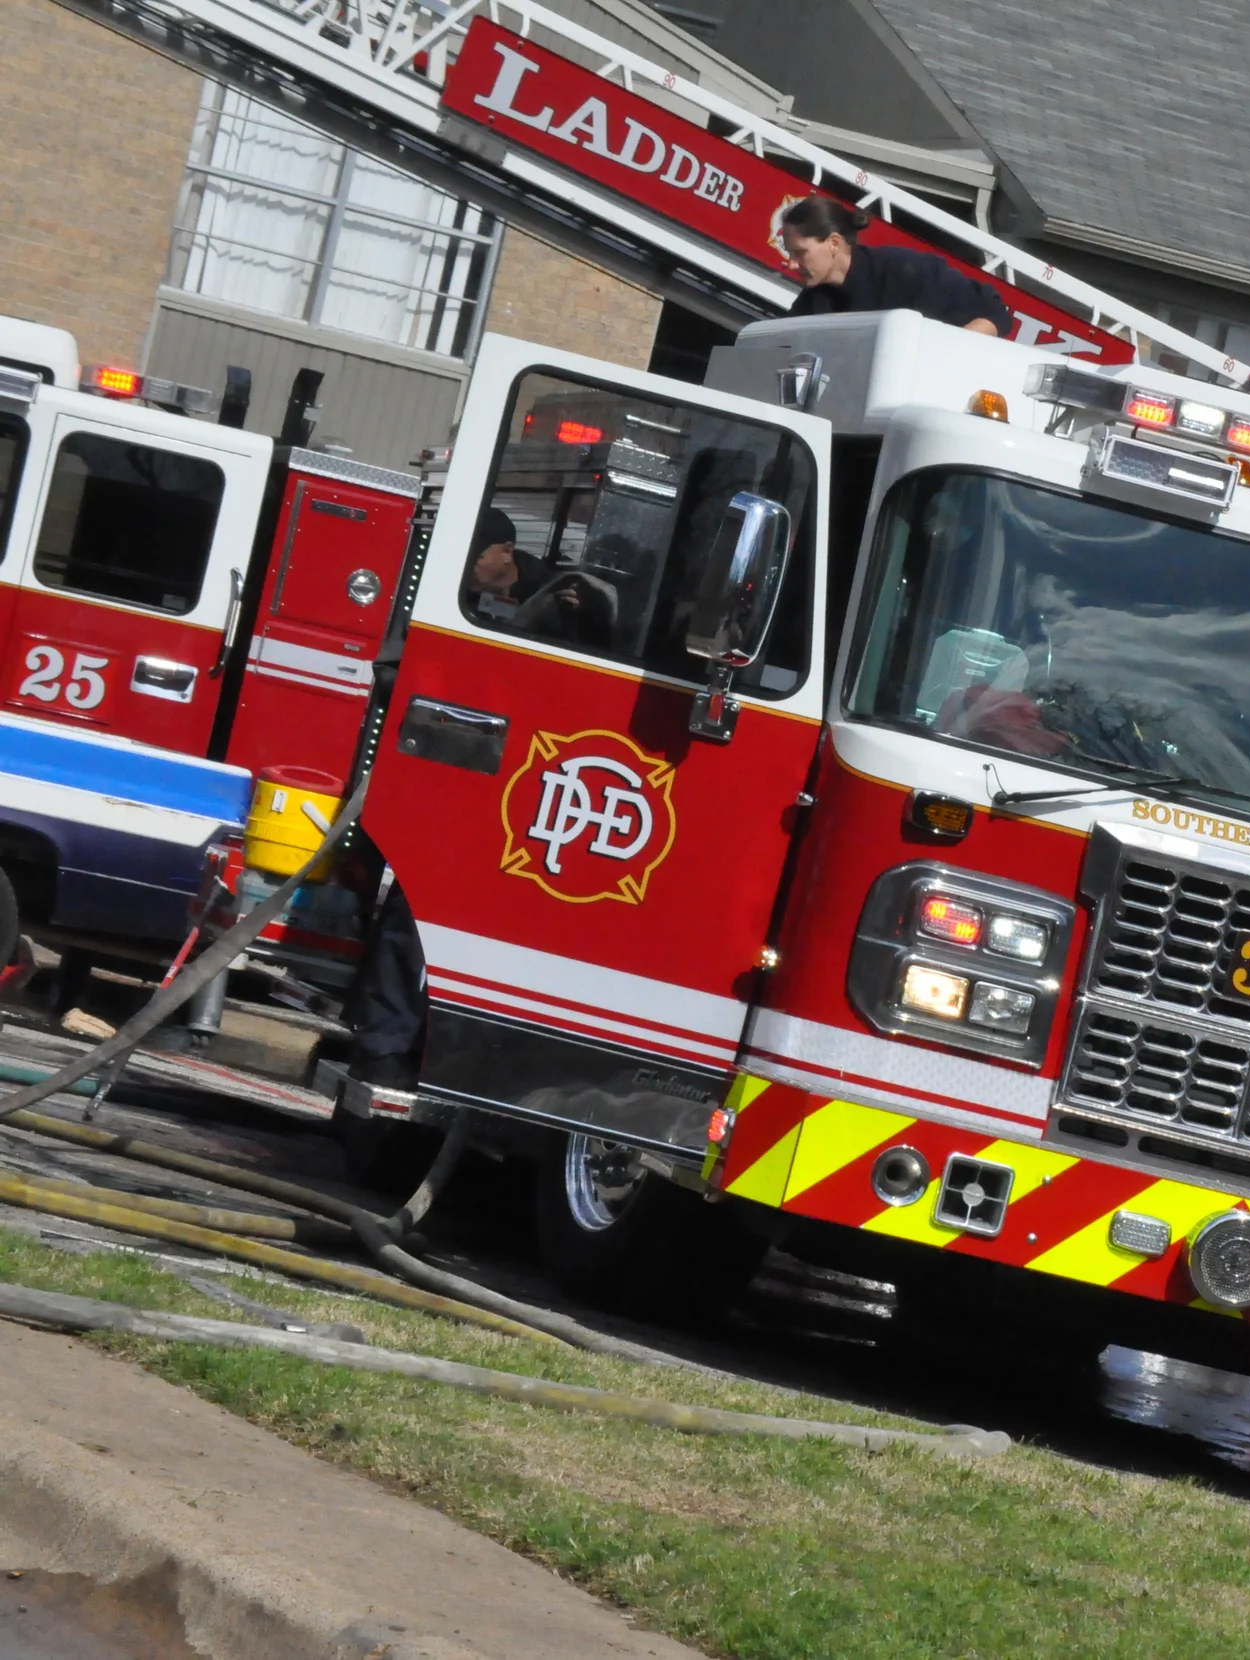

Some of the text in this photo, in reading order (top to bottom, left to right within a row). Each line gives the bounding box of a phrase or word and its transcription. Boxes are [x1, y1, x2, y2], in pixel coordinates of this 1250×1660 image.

[663, 73, 676, 89] 90
[474, 41, 744, 212] LADDER
[855, 172, 868, 186] 80
[1223, 358, 1235, 373] 60
[18, 644, 109, 710] 25
